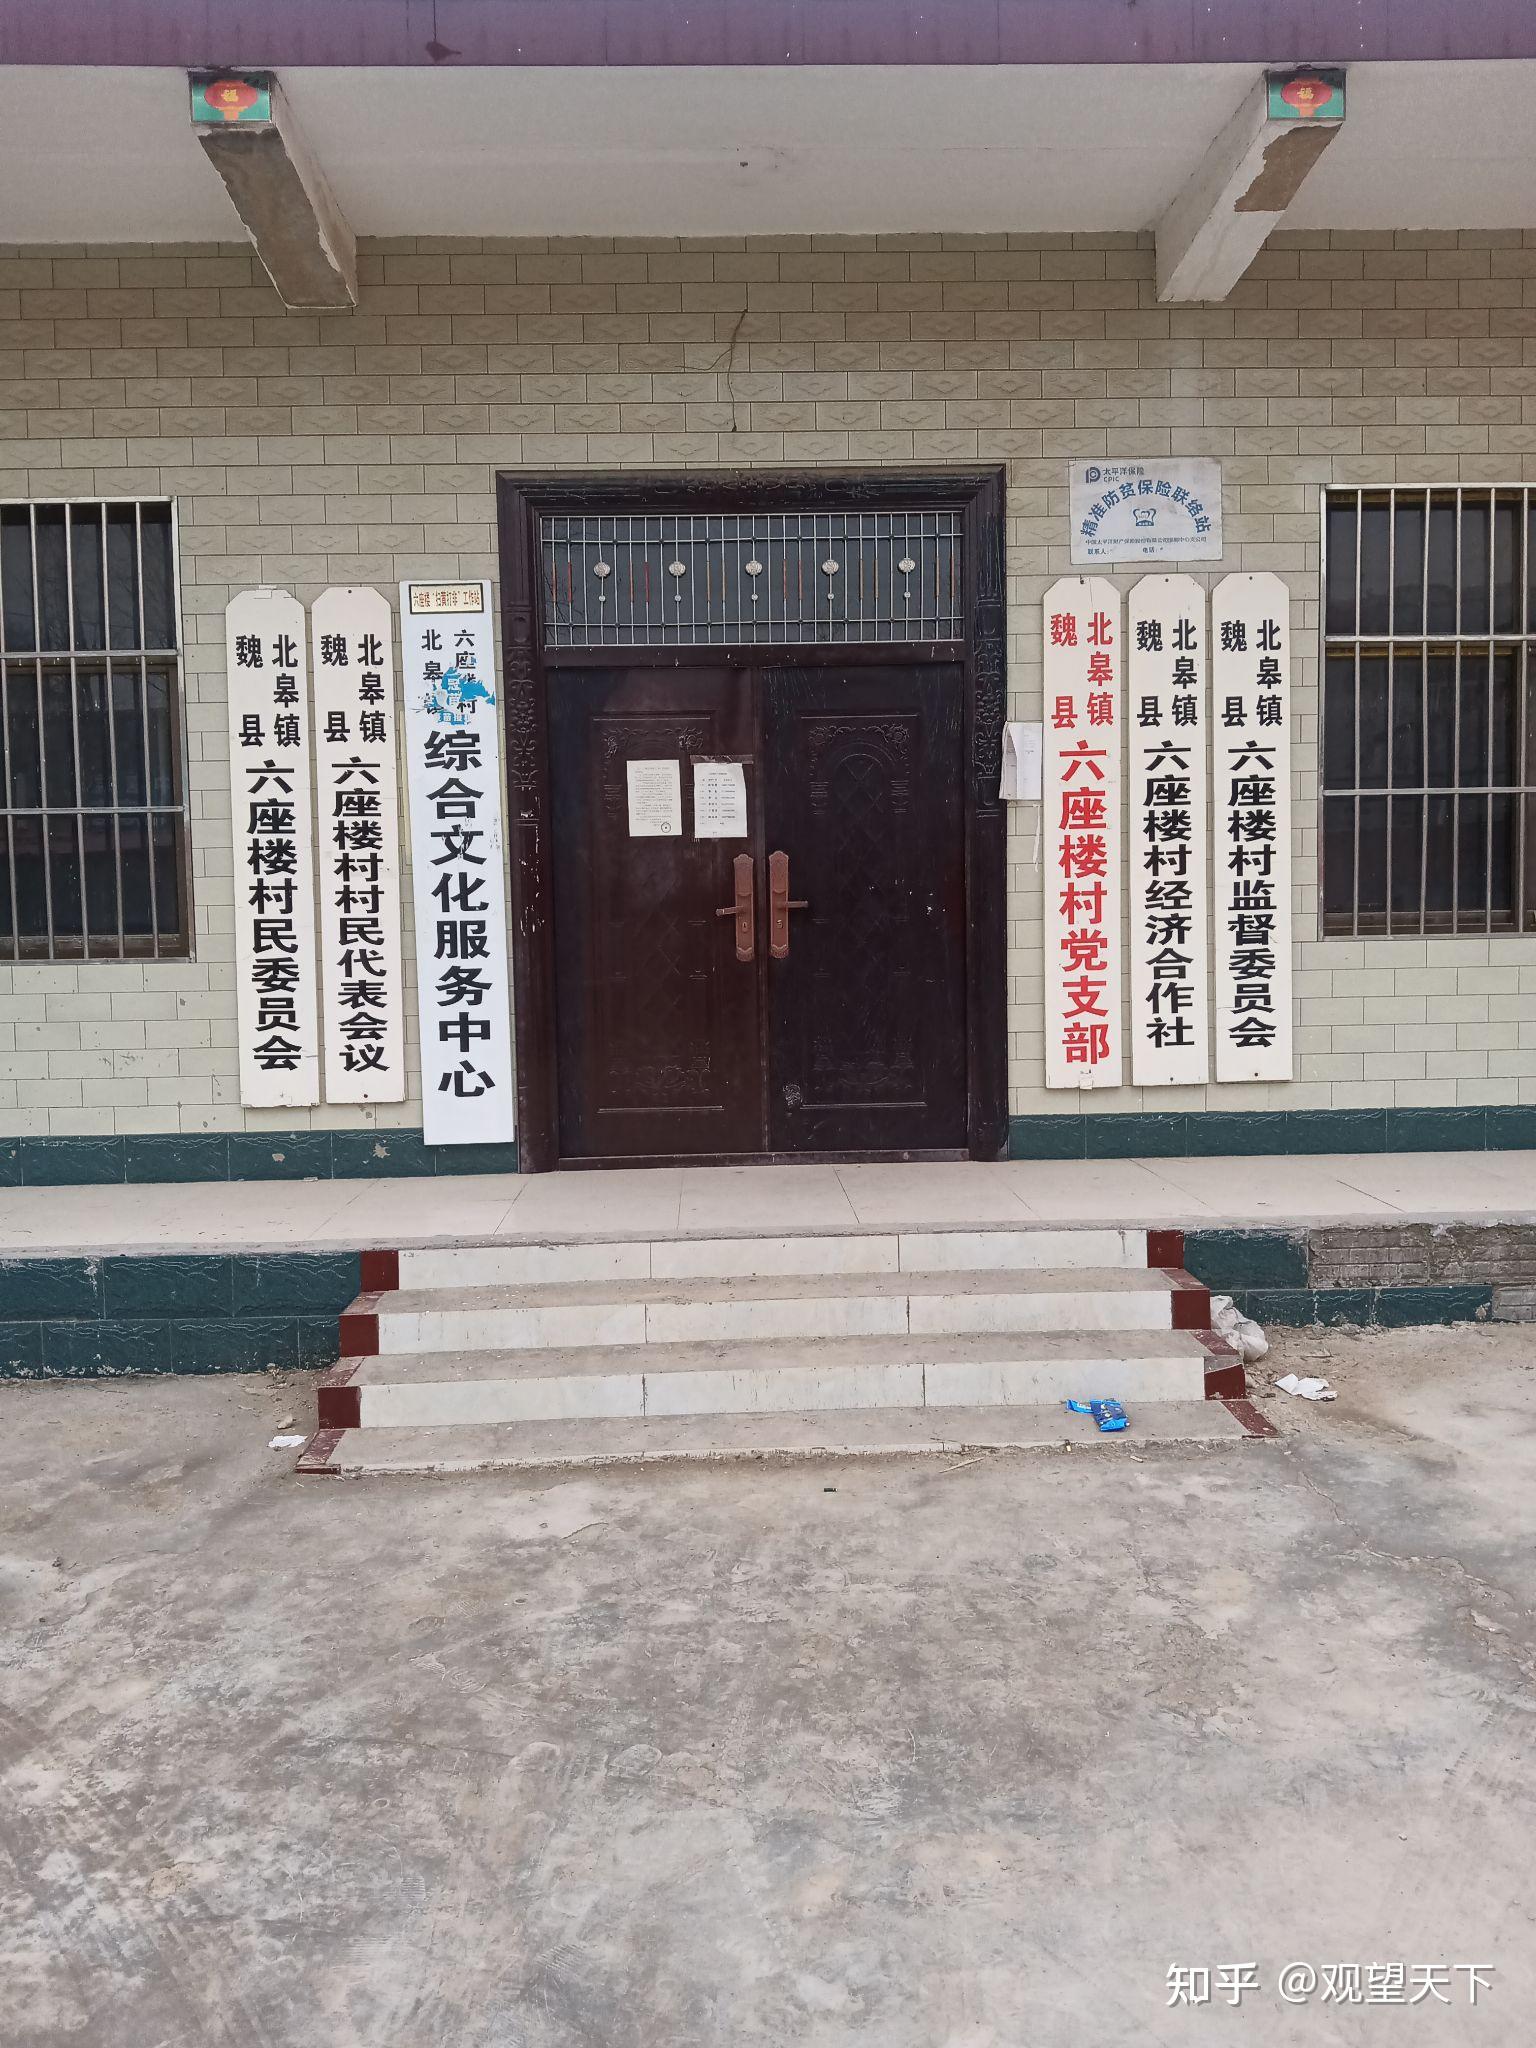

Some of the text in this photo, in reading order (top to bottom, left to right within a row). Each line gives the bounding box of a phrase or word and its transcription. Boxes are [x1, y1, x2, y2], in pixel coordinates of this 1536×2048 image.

[1080, 479, 1212, 538] 精准防贫保险联络站
[1102, 466, 1145, 476] 太平洋保险
[235, 634, 266, 748] 魏县
[271, 634, 301, 748] 北皋镇
[320, 634, 351, 743] 魏县
[357, 634, 387, 744] 北皋镇
[421, 629, 445, 715] 北皋
[1050, 613, 1078, 729] 魏县
[1086, 612, 1114, 728] 北皋镇
[1136, 619, 1164, 728] 魏县
[1171, 618, 1198, 728] 北皋镇
[1220, 619, 1248, 728] 魏县
[1256, 618, 1283, 728] 北皋镇
[246, 759, 303, 1072] 六座楼村民委员会
[331, 756, 390, 1073] 六座楼村村民代表会议
[424, 730, 496, 1098] 综合文化服务中心
[1059, 740, 1110, 1065] 六座楼村党支部
[1143, 739, 1195, 1049] 六座楼村经济合作社
[1227, 739, 1277, 1049] 六座楼村监督委员会
